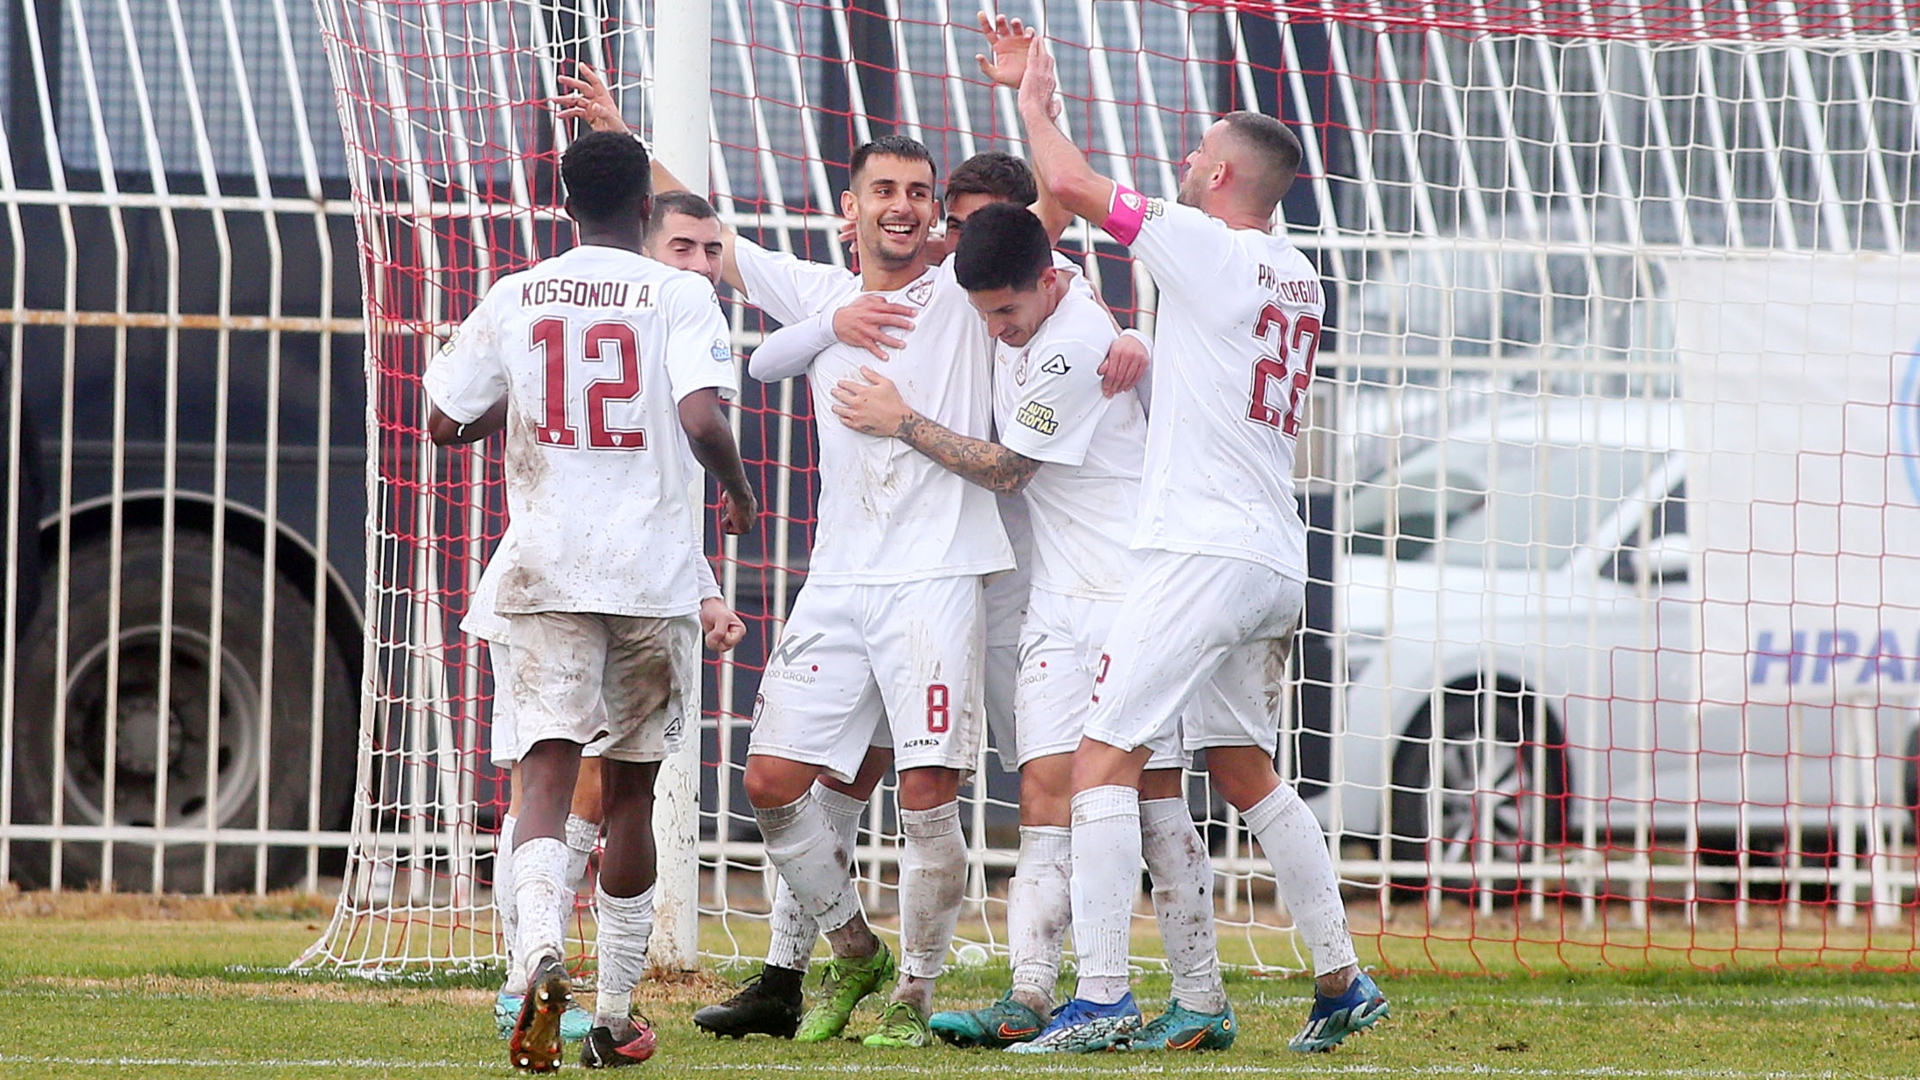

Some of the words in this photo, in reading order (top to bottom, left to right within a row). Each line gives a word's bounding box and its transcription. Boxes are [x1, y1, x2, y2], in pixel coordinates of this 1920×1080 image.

[521, 278, 629, 307] KOSSONOU
[635, 284, 653, 308] A.
[529, 314, 648, 450] 12
[1245, 300, 1321, 440] 22
[782, 671, 816, 685] GROUP
[1019, 673, 1048, 689] GROUP
[927, 684, 949, 733] 8
